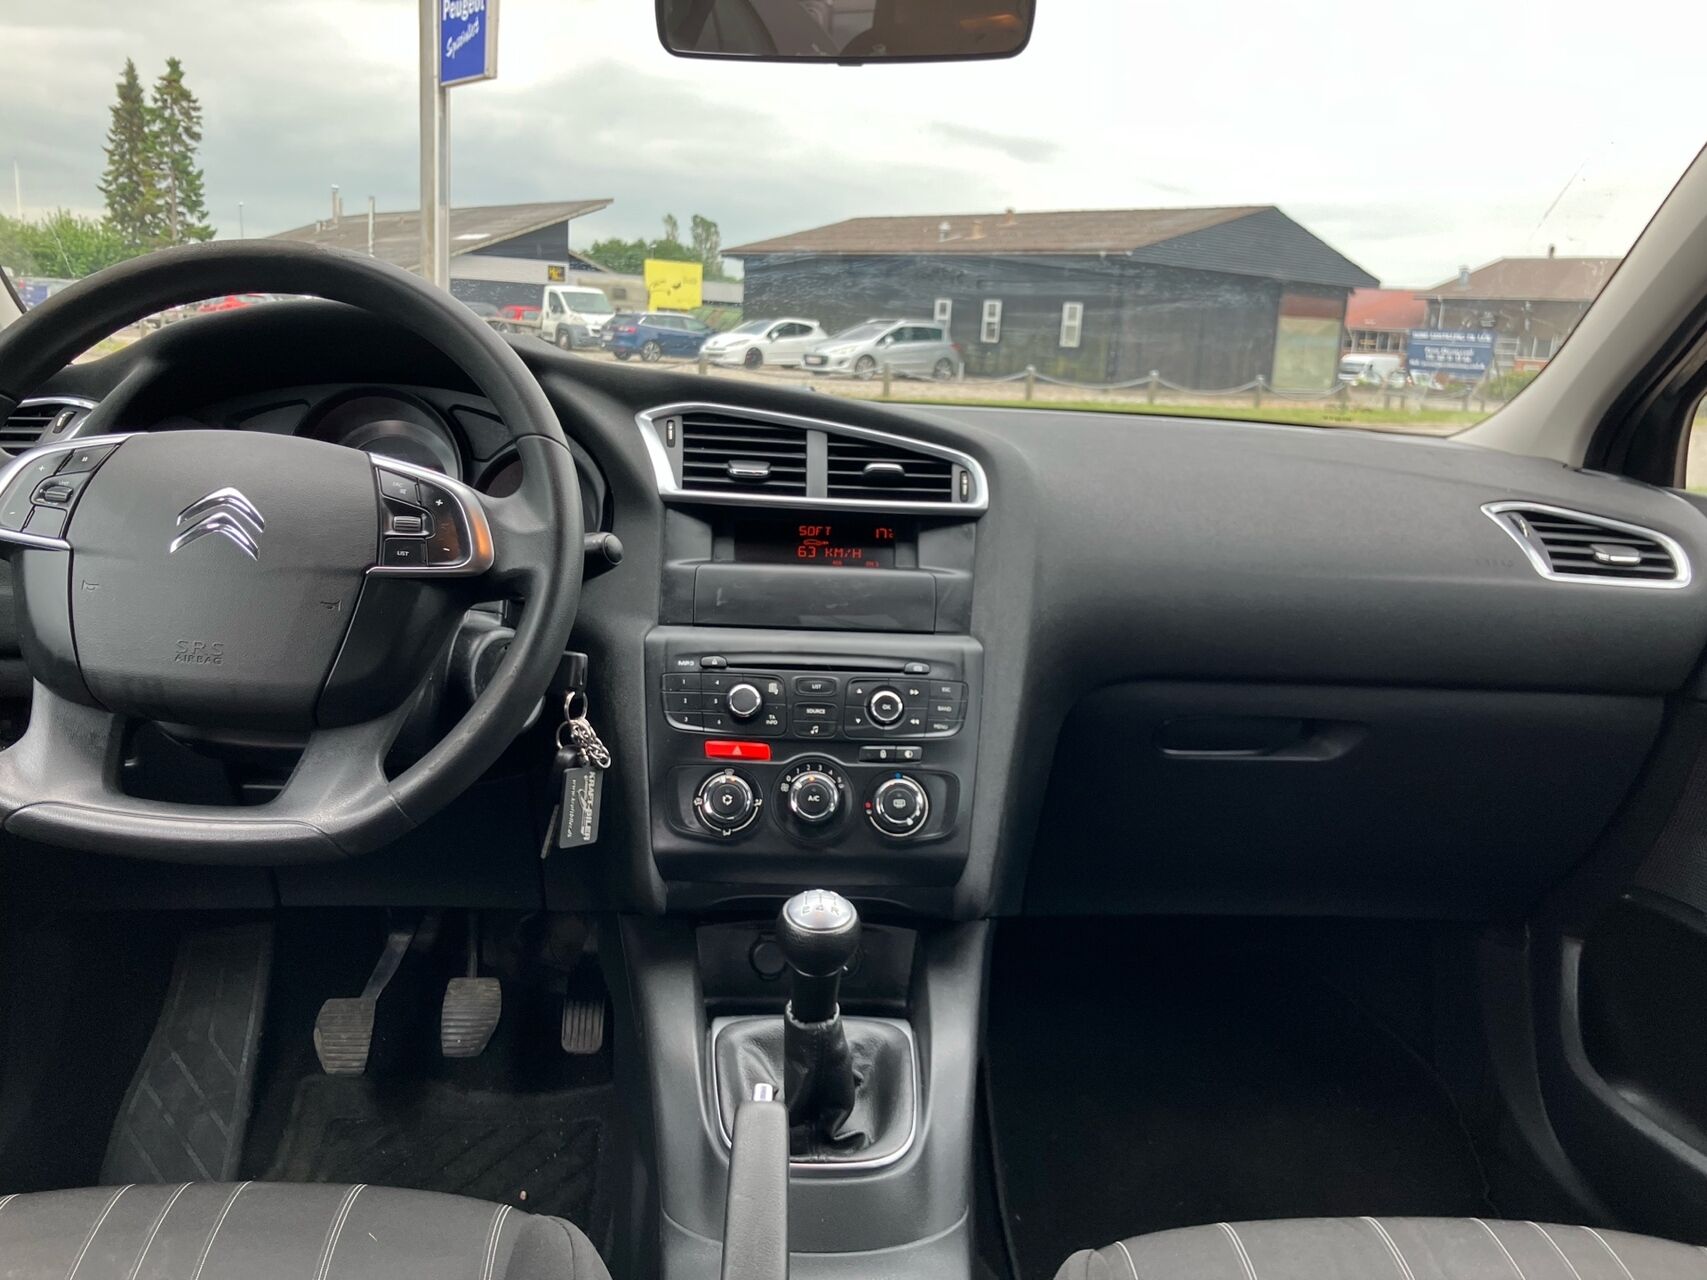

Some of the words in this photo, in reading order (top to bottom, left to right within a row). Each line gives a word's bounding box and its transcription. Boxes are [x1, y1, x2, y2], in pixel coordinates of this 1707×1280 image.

[443, 0, 485, 21] Peugeot
[798, 525, 832, 537] SOFT
[797, 546, 816, 558] 63
[824, 547, 862, 559] KM/H
[175, 639, 225, 656] SRS
[173, 653, 223, 665] AIRBAG
[881, 703, 892, 711] OK
